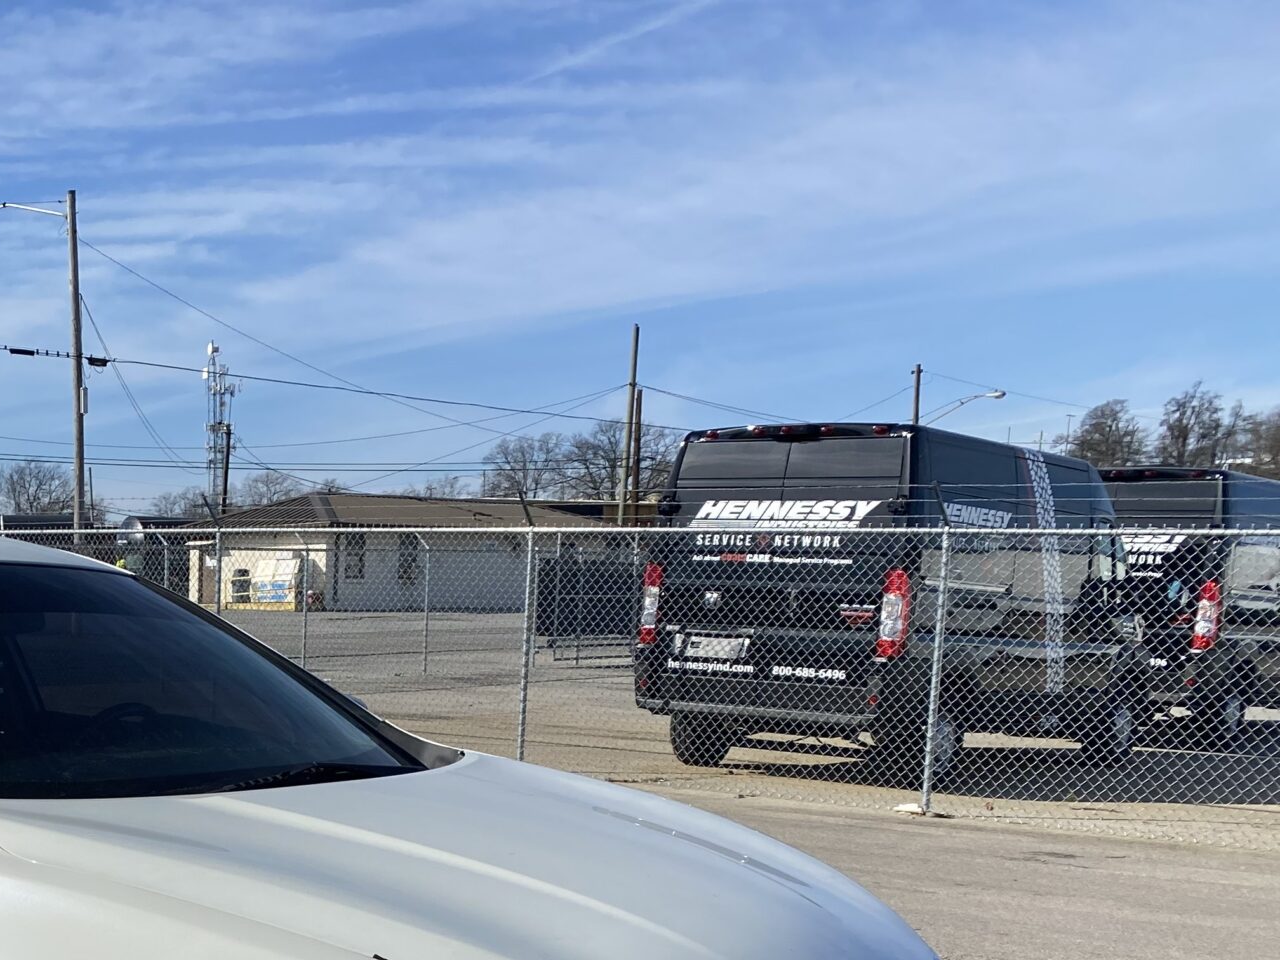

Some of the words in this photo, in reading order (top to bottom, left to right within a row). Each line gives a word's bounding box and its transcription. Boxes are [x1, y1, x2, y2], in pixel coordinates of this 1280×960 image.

[695, 500, 882, 519] HENNESSY
[943, 502, 1013, 528] HENNESSY
[696, 534, 752, 546] SERVICE
[774, 535, 841, 548] NETWORK
[1128, 554, 1163, 565] WORK
[668, 658, 754, 673] hennessyind.com
[772, 665, 846, 680] 800-688-6496
